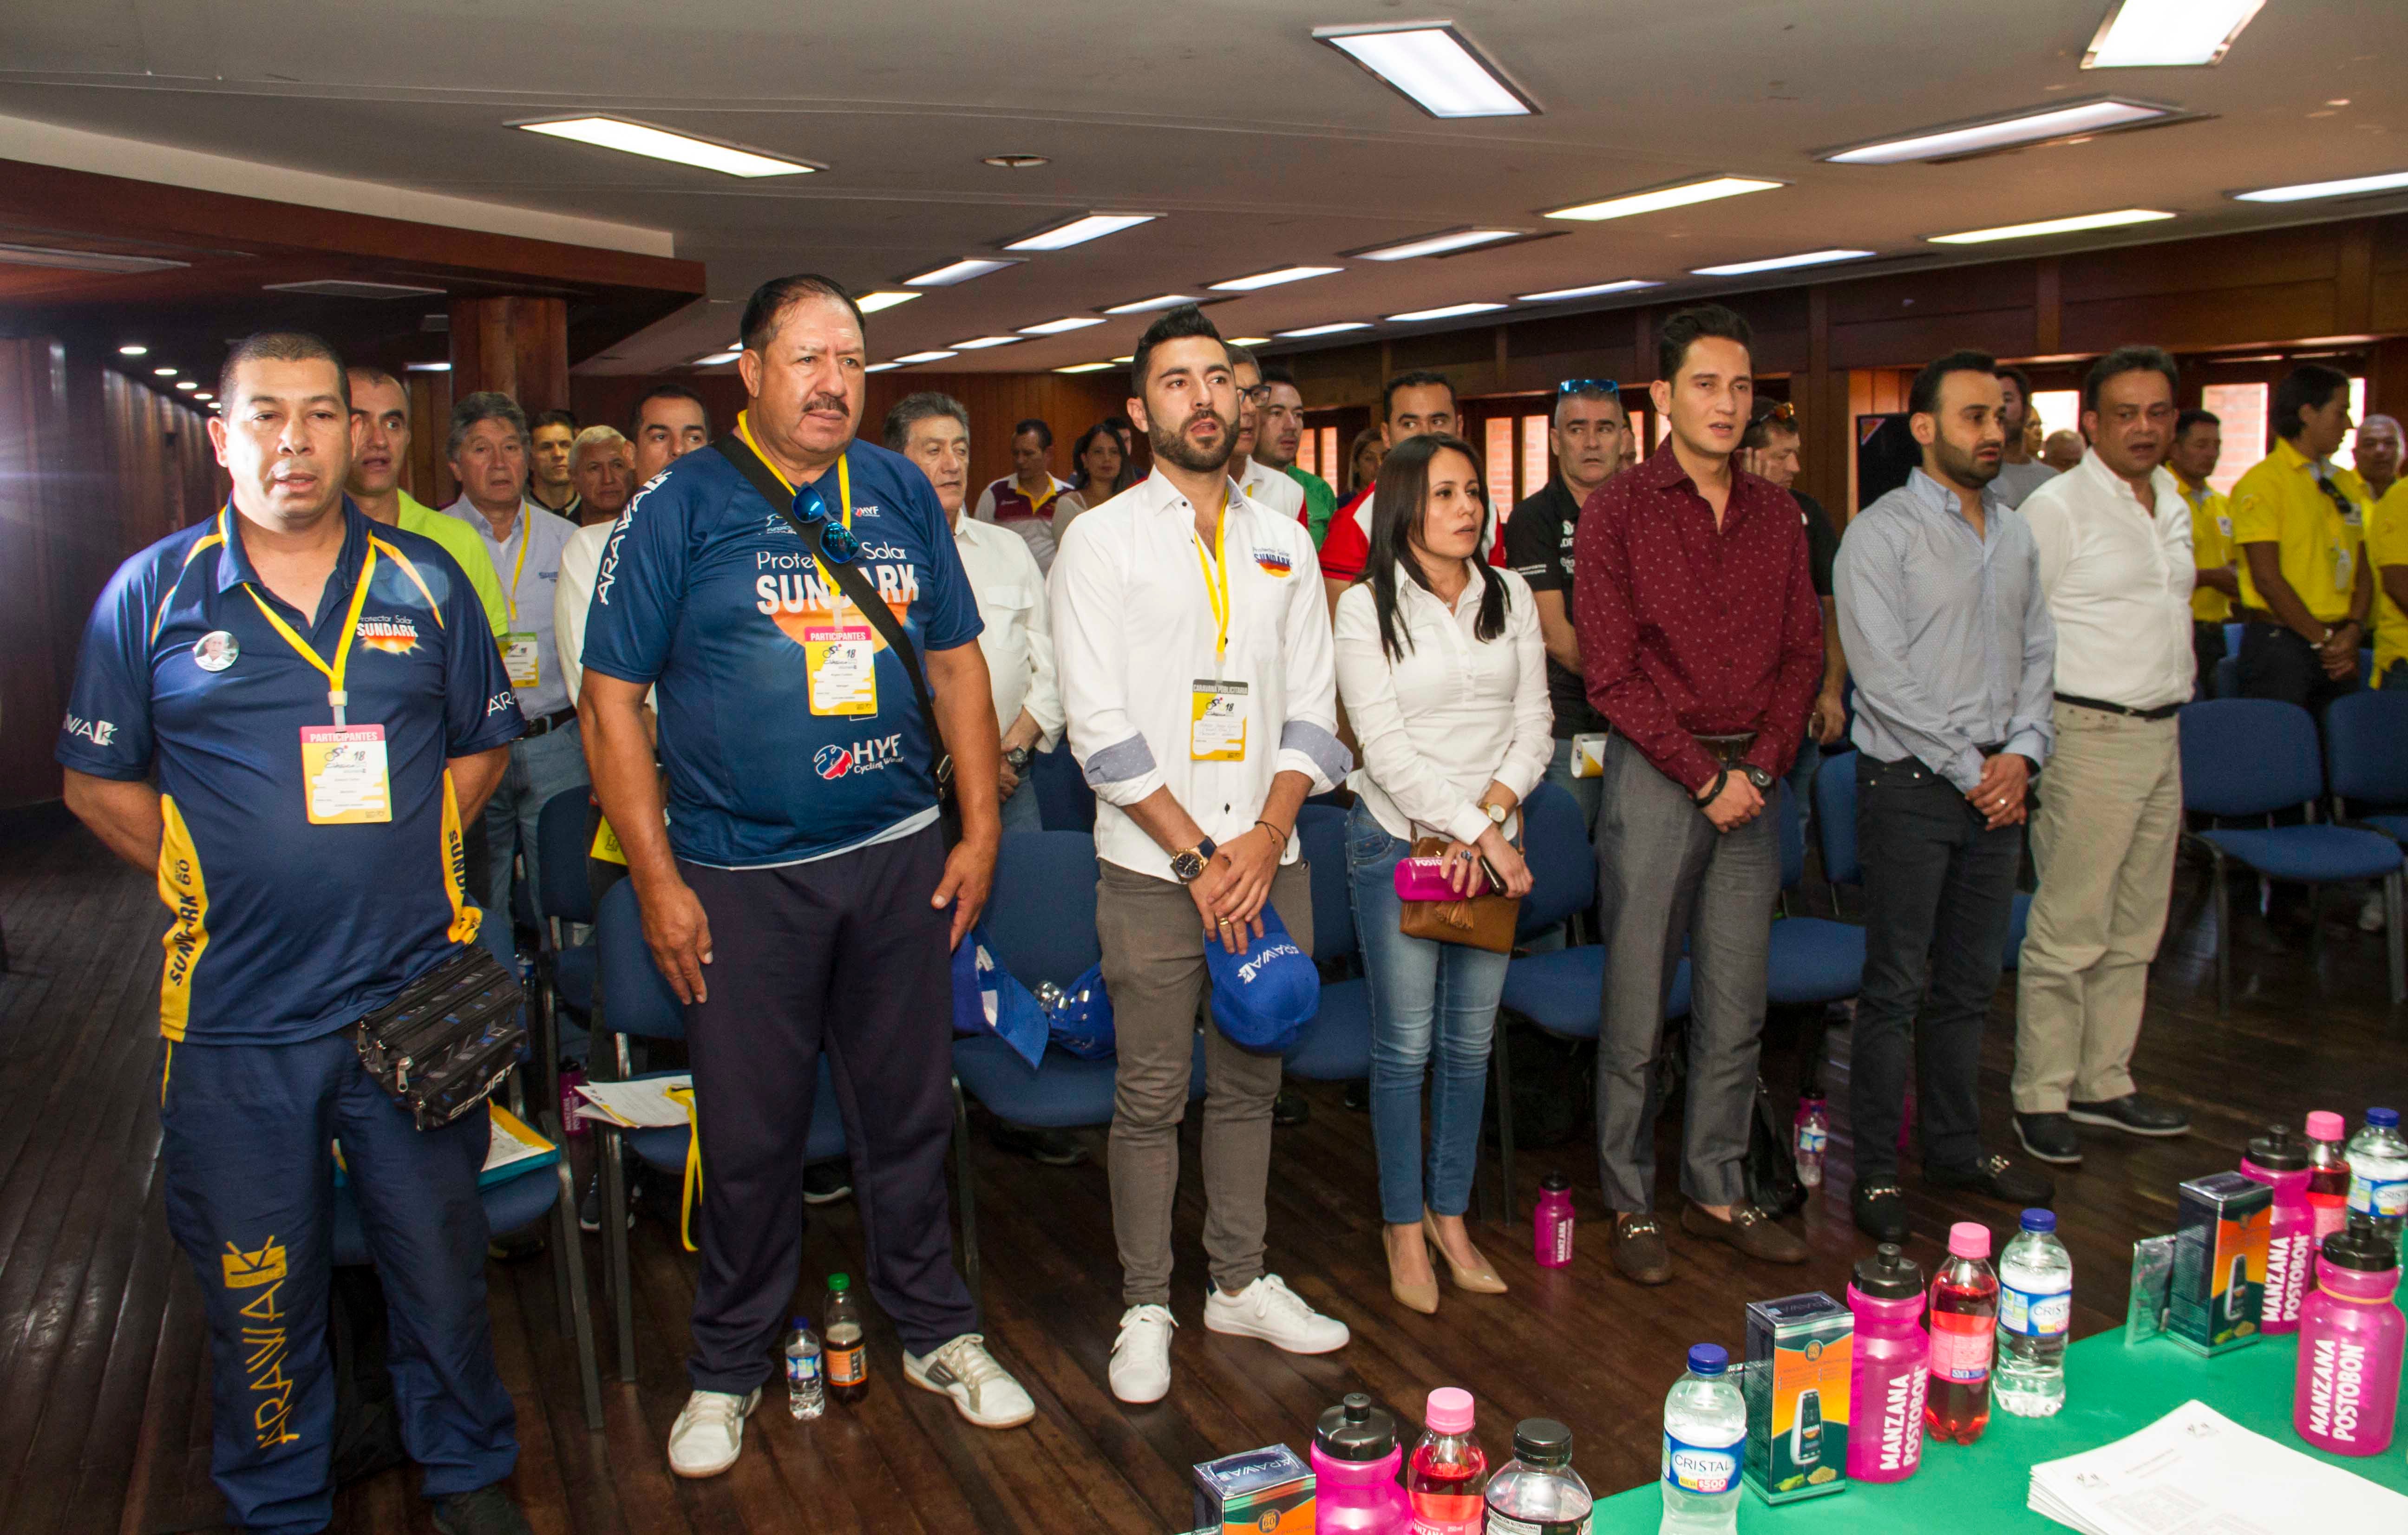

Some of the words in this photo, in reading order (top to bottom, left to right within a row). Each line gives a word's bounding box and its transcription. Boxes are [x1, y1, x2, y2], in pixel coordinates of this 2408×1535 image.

[757, 551, 818, 570] Prote
[862, 542, 907, 560] Solar
[756, 564, 919, 615] SUNRK
[395, 615, 413, 624] Solar
[357, 623, 419, 637] SUNDARK
[811, 632, 866, 641] PARTICIPANTES
[310, 732, 378, 743] PARTICIPANTES
[853, 733, 902, 764] HYF
[854, 761, 883, 775] Cycling
[2261, 1237, 2291, 1321] MANZANA
[2309, 1339, 2336, 1436] MANZANA
[1880, 1374, 1910, 1470] MANZANA
[1675, 1454, 1731, 1472] CRISTAL
[1511, 1522, 1539, 1531] NUTRICIONAL
